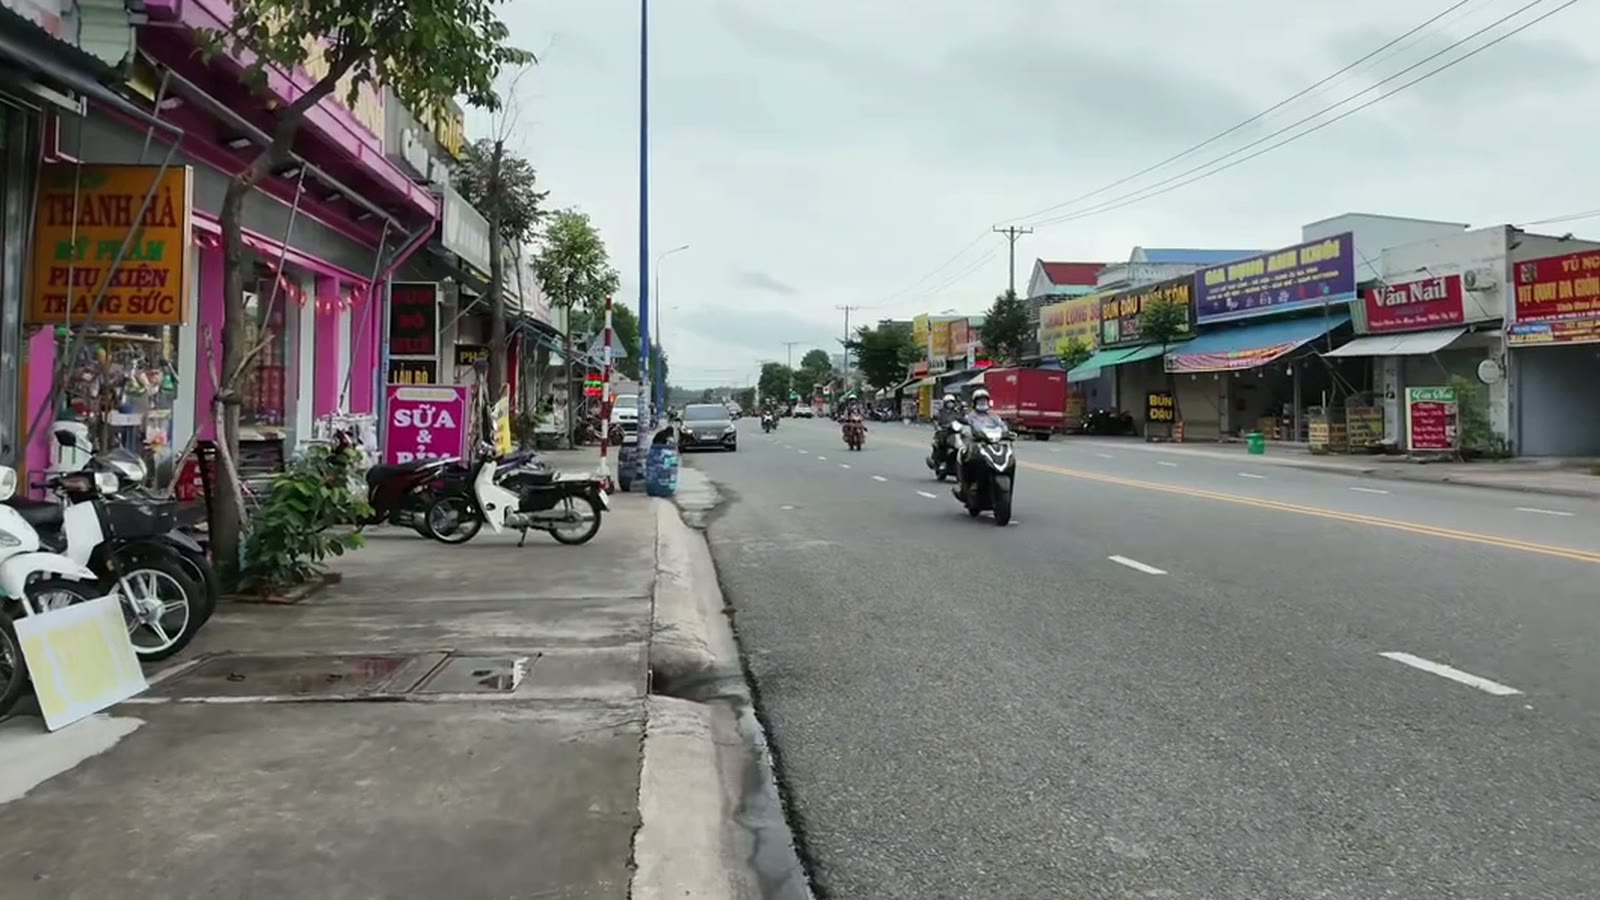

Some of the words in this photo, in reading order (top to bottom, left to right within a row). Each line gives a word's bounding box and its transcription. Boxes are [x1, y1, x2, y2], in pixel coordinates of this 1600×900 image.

[47, 193, 133, 227] THANH
[140, 186, 177, 227] HÀ
[49, 267, 100, 293] PHỤ
[107, 263, 169, 292] KIỆN
[127, 291, 174, 314] SỨC
[1372, 286, 1407, 307] Vân
[1409, 278, 1447, 303] Nail
[1149, 393, 1172, 406] BÚN
[394, 404, 456, 428] SỮA
[416, 429, 432, 443] &
